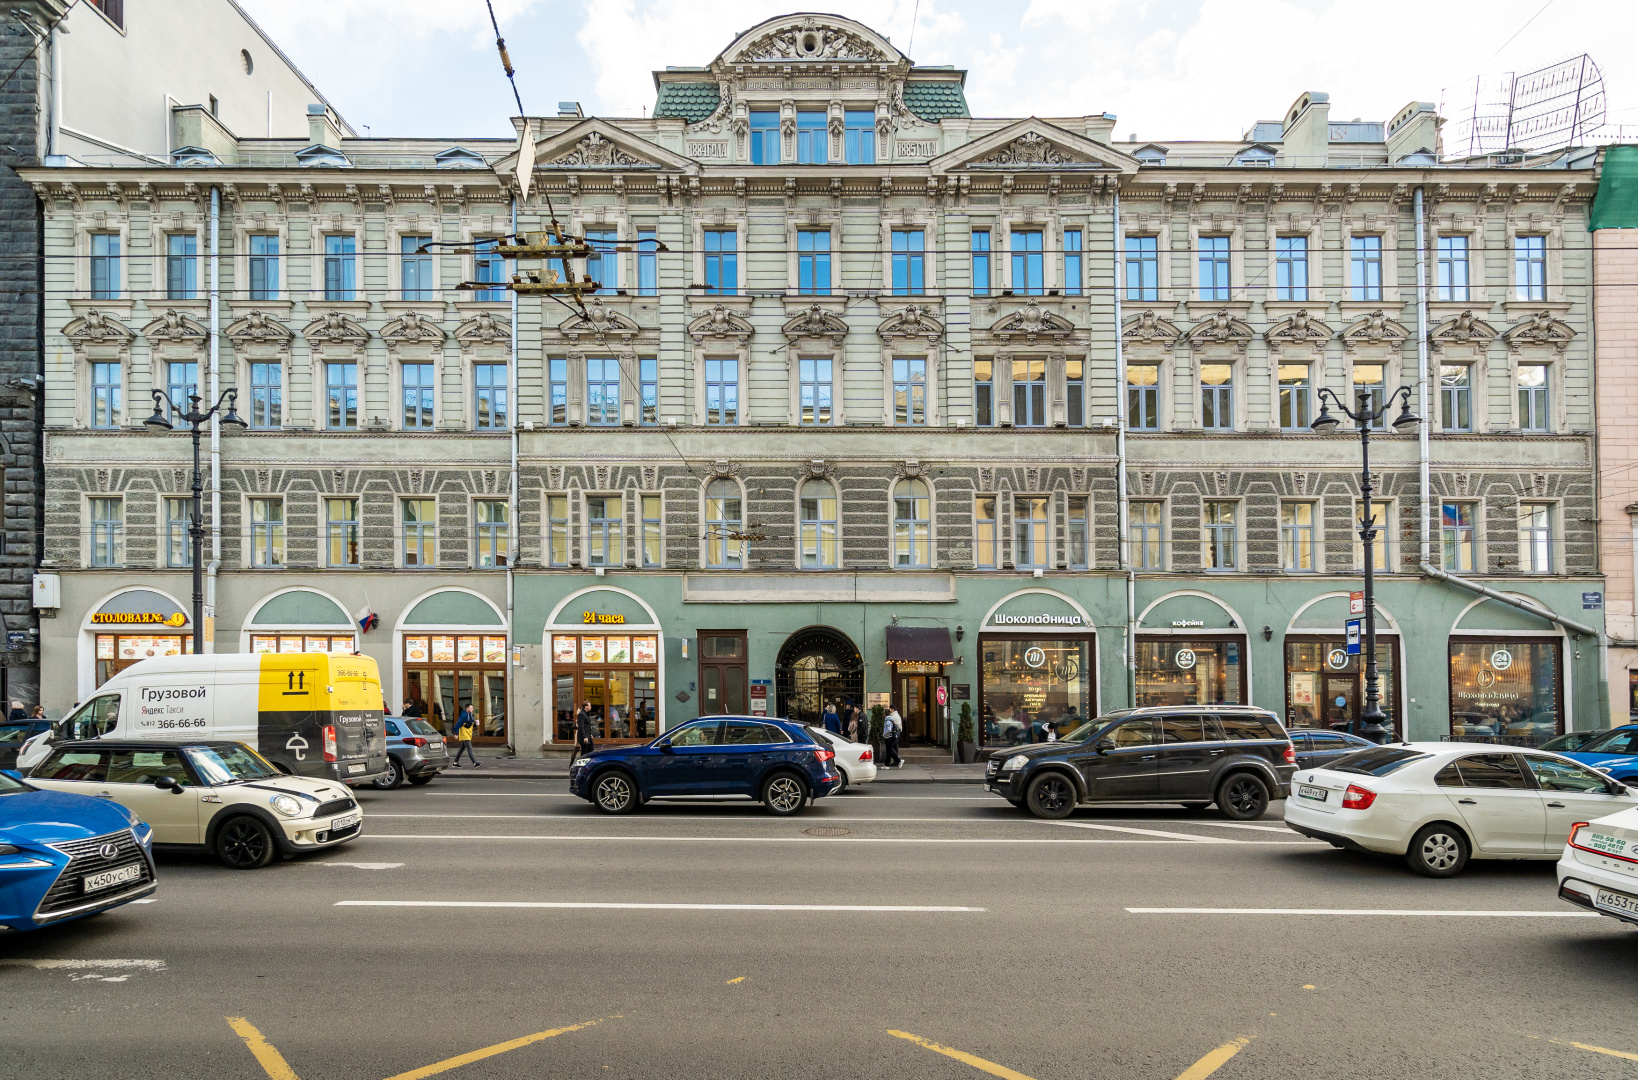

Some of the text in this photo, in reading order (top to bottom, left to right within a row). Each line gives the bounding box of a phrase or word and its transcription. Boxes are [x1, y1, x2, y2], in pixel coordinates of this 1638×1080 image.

[91, 613, 150, 623] СТОЛОВАЯ
[583, 611, 625, 624] 24 часа
[994, 613, 1081, 625] Шоколадница
[1172, 619, 1204, 628] кофейня
[1180, 652, 1192, 661] 24
[1496, 653, 1508, 662] 24
[141, 686, 206, 702] Грузовой
[141, 704, 184, 715] Яндекс Такси
[157, 718, 206, 729] 366-66-66
[339, 715, 362, 725] Грузовой
[87, 865, 139, 889] Х450УС 178
